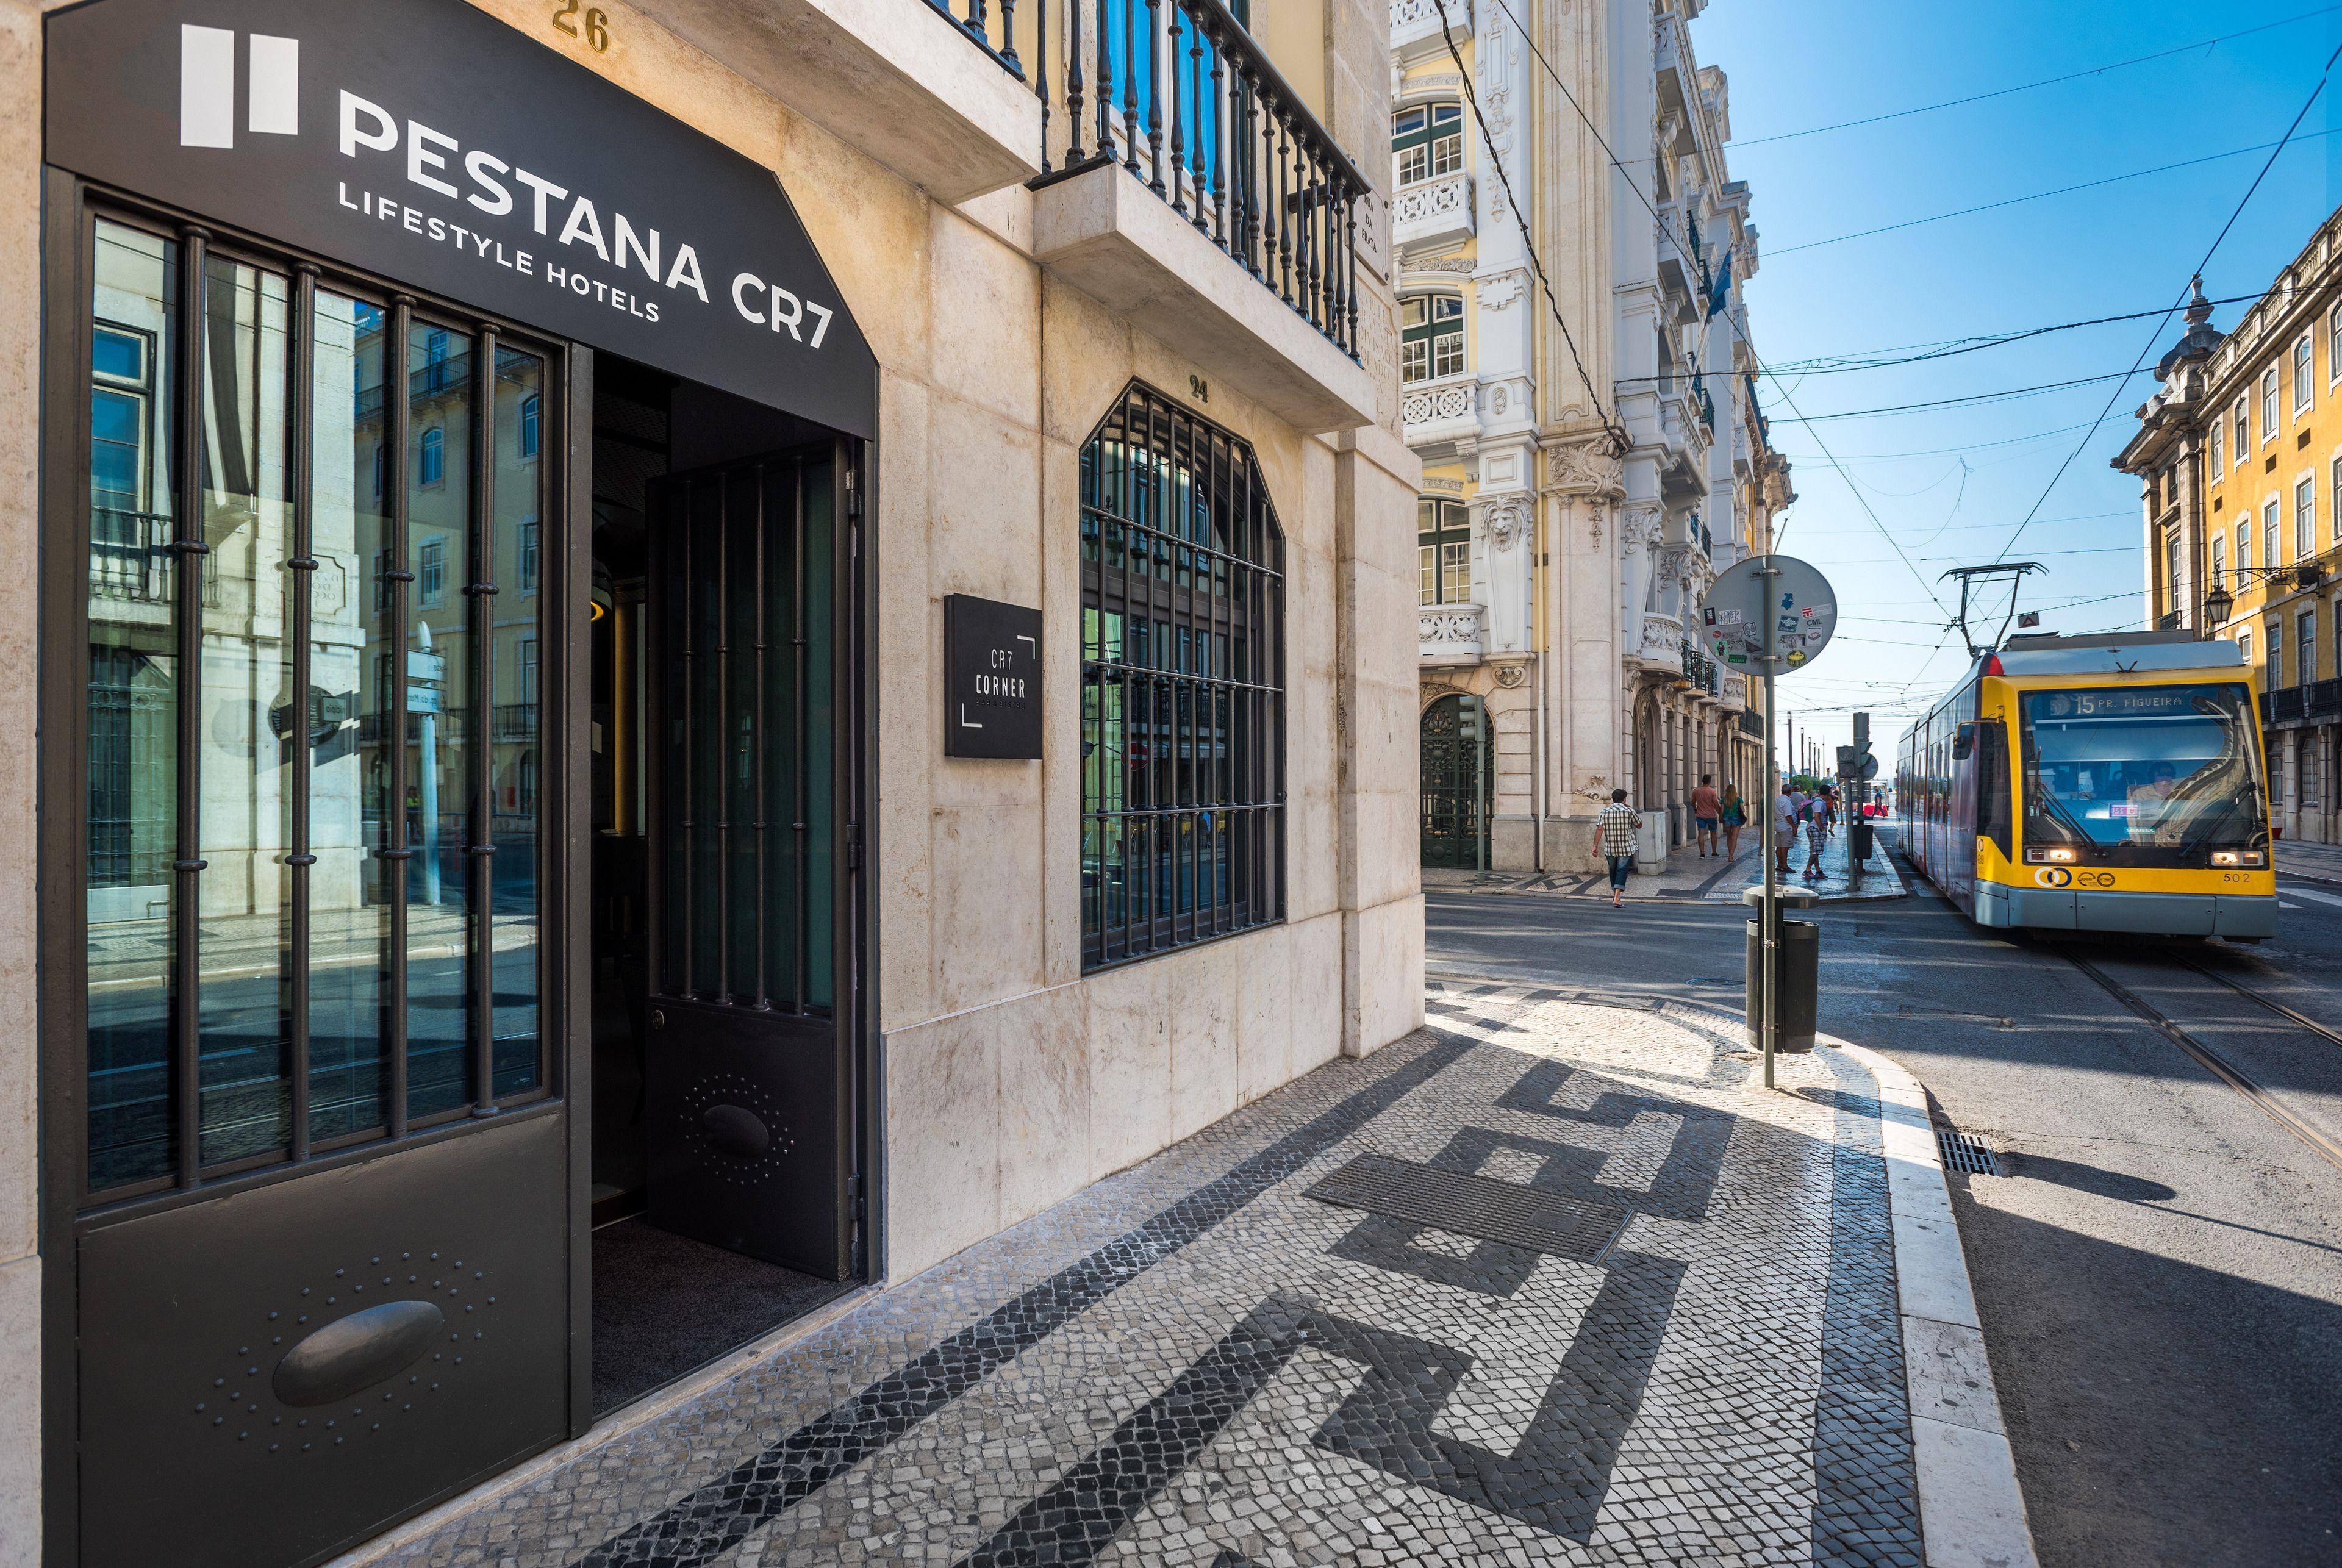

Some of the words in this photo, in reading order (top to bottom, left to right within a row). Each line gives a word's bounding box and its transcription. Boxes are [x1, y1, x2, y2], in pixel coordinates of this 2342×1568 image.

[553, 0, 609, 54] 26
[1364, 194, 1374, 213] RUA
[340, 89, 709, 304] PESTANA
[731, 272, 834, 350] CR7
[1366, 213, 1373, 230] DA
[1361, 227, 1377, 253] PRATA
[339, 182, 534, 276] LIFESTYLE
[547, 261, 660, 323] HOTELS
[1189, 374, 1209, 403] 24
[991, 648, 1012, 670] CR7
[976, 674, 1025, 698] CORNER
[2075, 695, 2094, 714] 15
[2098, 700, 2117, 708] PR.
[2125, 697, 2182, 707] FIGUEIRA
[2223, 873, 2250, 882] 502
